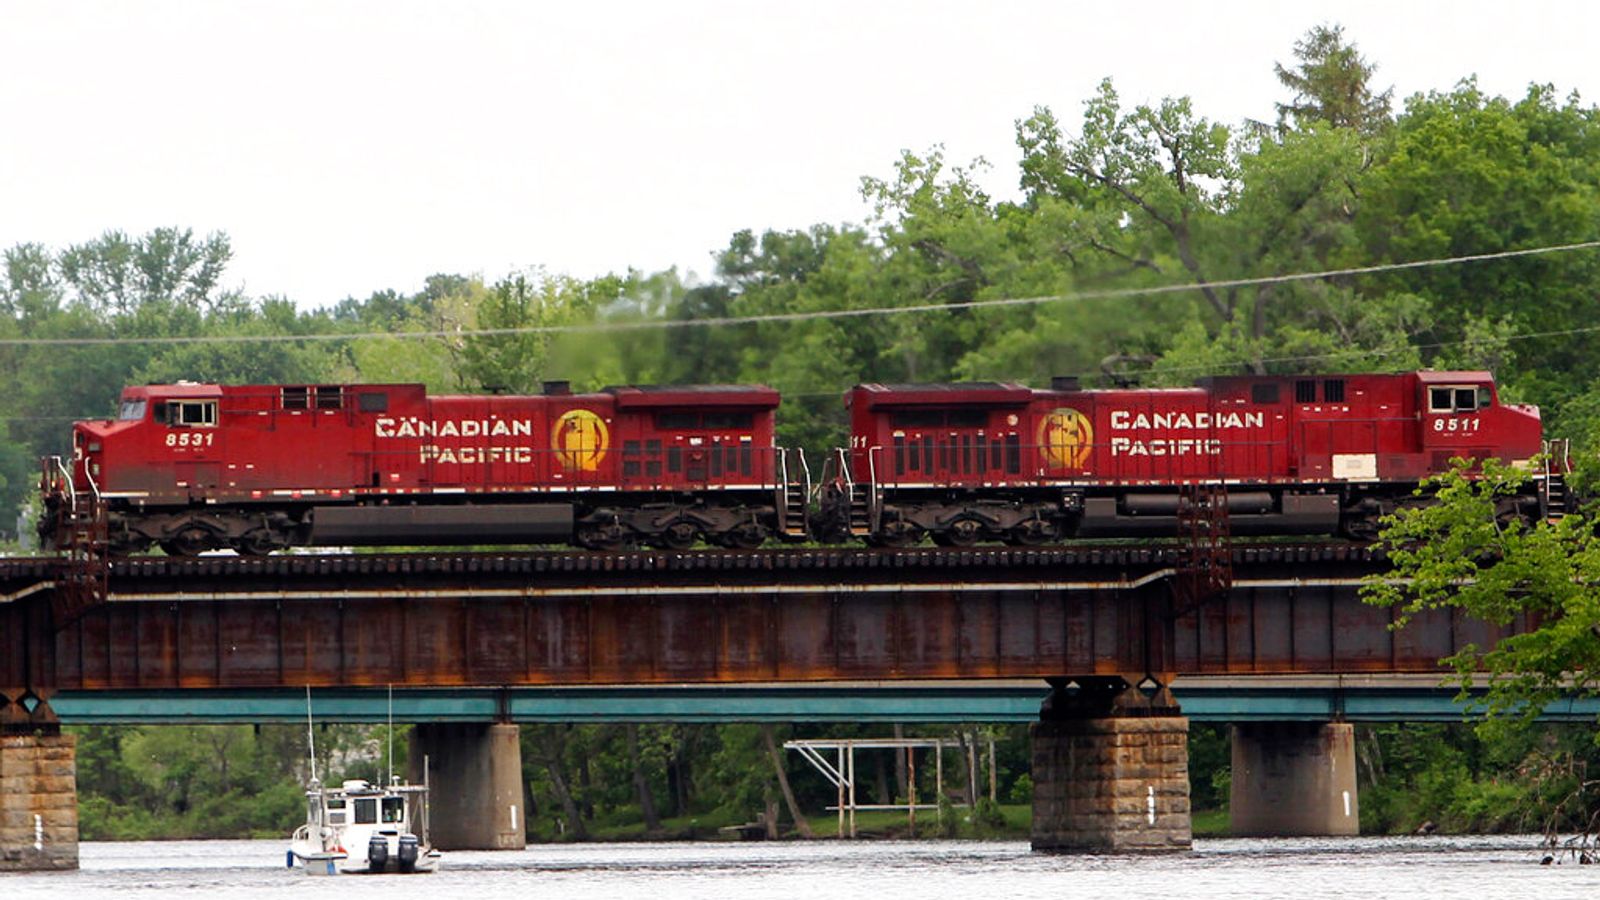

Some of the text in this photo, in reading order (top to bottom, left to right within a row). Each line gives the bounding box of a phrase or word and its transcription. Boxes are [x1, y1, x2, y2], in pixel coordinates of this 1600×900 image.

[375, 418, 532, 438] CANADIAN
[1110, 411, 1264, 430] CANADIAN
[1433, 418, 1480, 431] 8511
[165, 432, 214, 447] 8531
[1111, 438, 1221, 456] PACIFIC
[420, 444, 532, 464] PACIFIC
